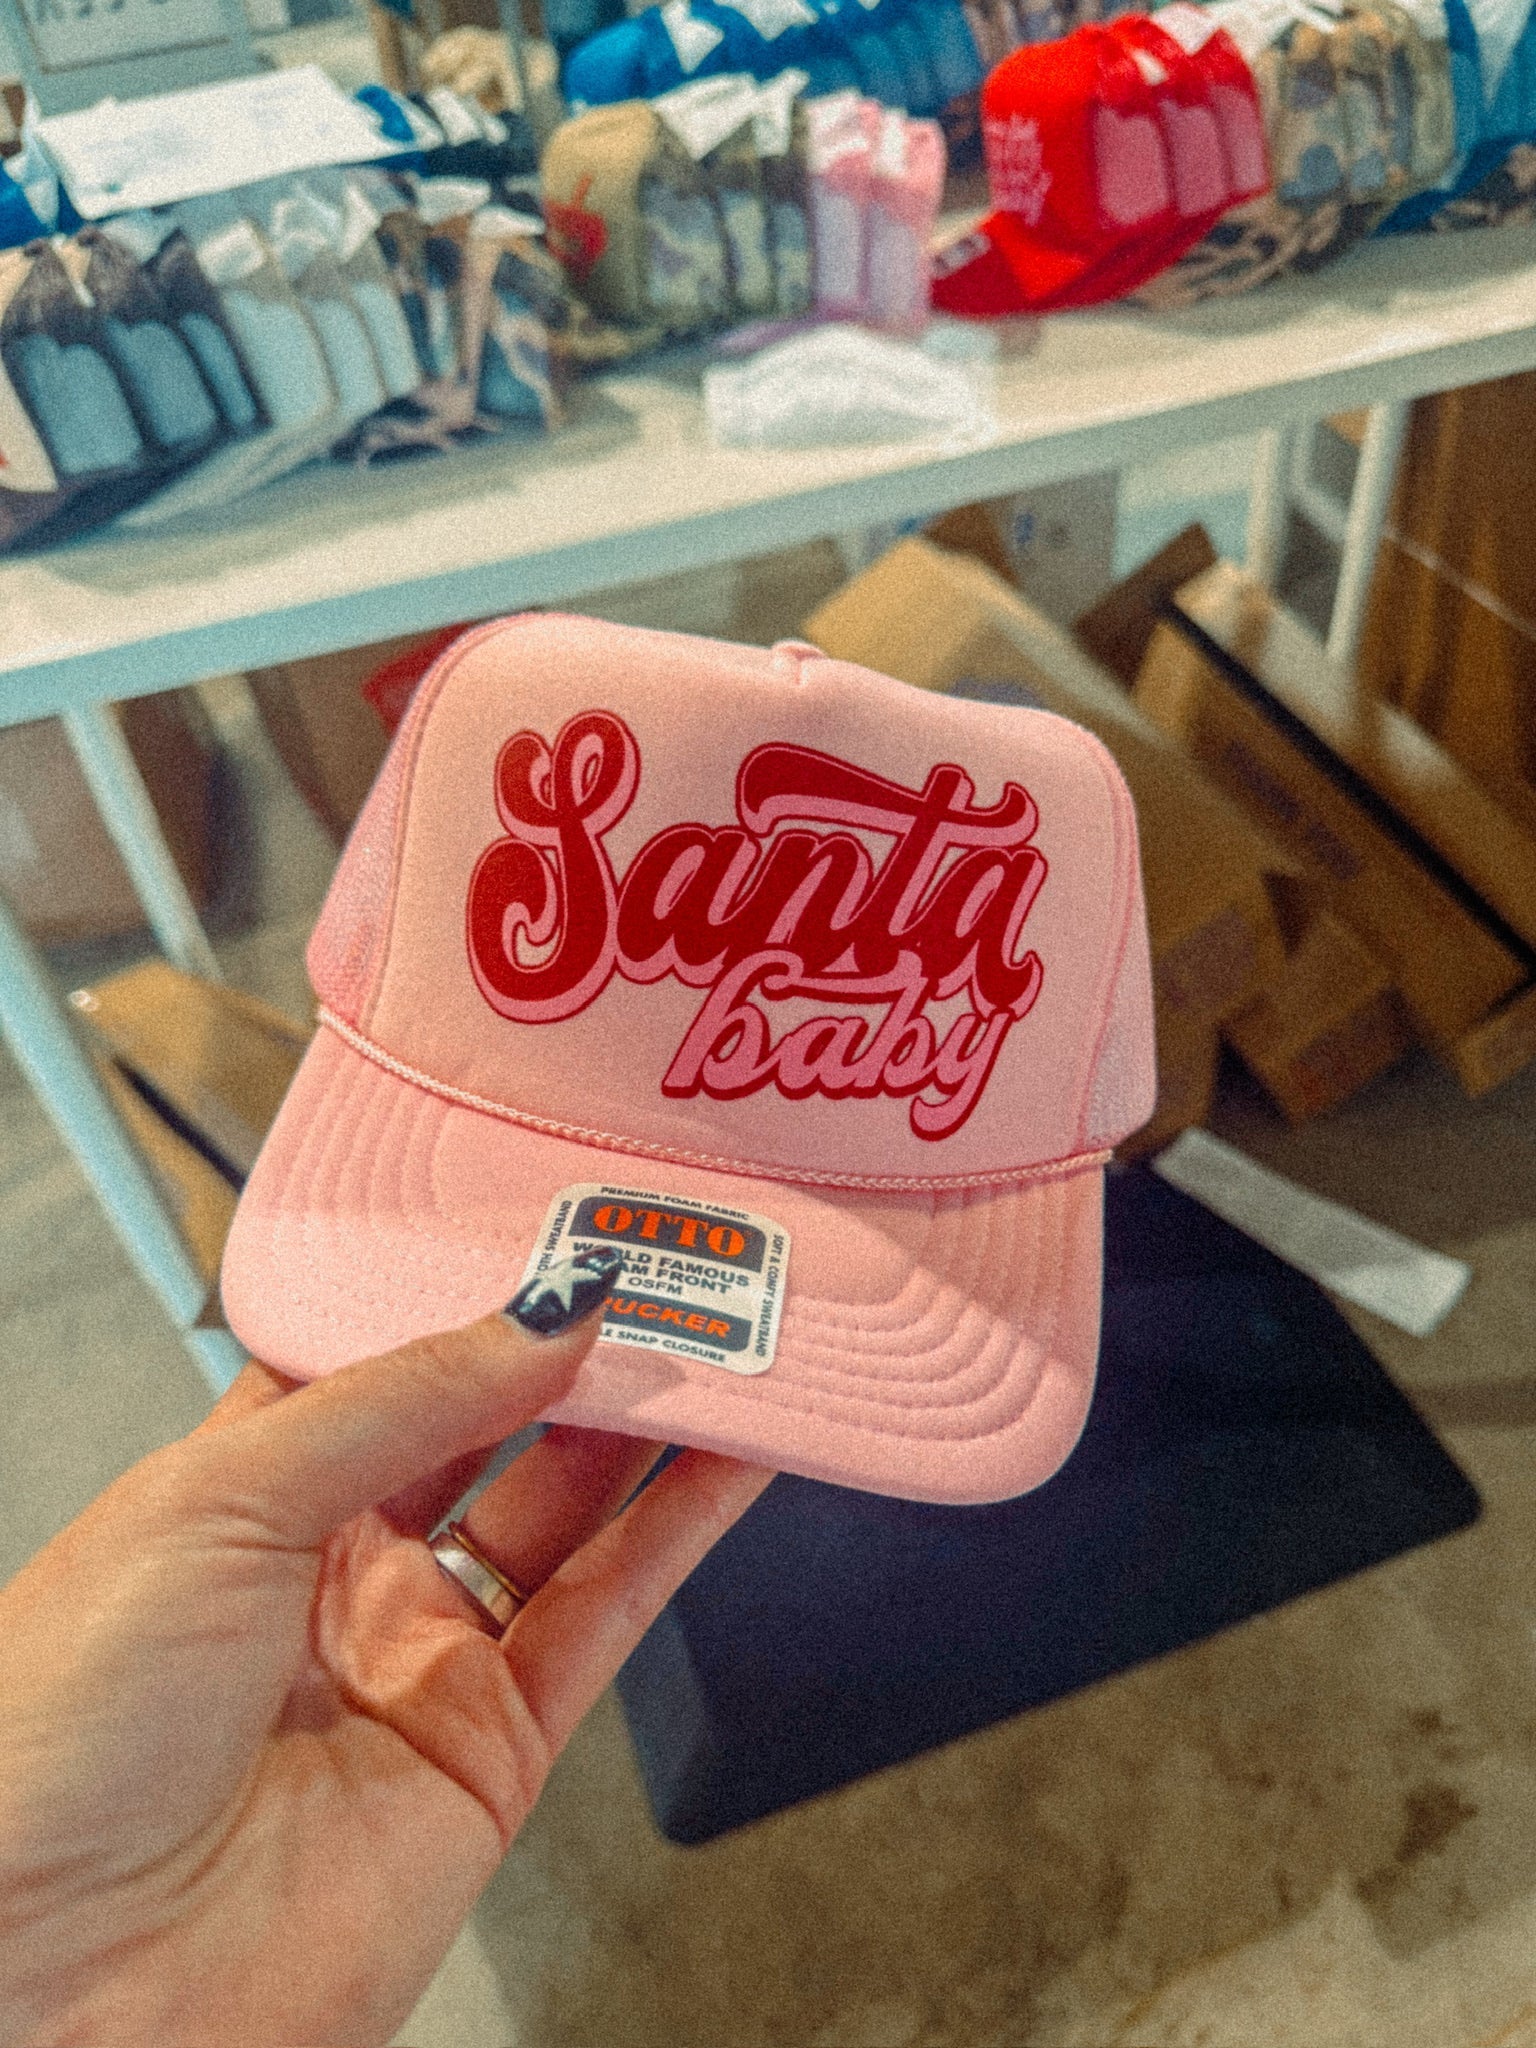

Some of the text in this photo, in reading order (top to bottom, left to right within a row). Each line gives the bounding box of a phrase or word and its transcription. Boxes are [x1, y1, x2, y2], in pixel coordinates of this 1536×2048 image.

[466, 709, 1048, 1024] Santa
[661, 948, 1014, 1141] baby
[545, 1200, 572, 1251] SWEATBAND
[601, 1186, 749, 1220] PREMIUM FOAM FABRIC
[593, 1204, 745, 1257] OTTO
[573, 1242, 750, 1287] WLD FAMOUS
[628, 1277, 682, 1295] OSFM
[656, 1267, 732, 1294] FRONT
[604, 1296, 731, 1338] UCKER
[755, 1298, 773, 1357] SWEATBAND
[617, 1330, 658, 1344] SNAP
[662, 1339, 726, 1362] CLOSURE
